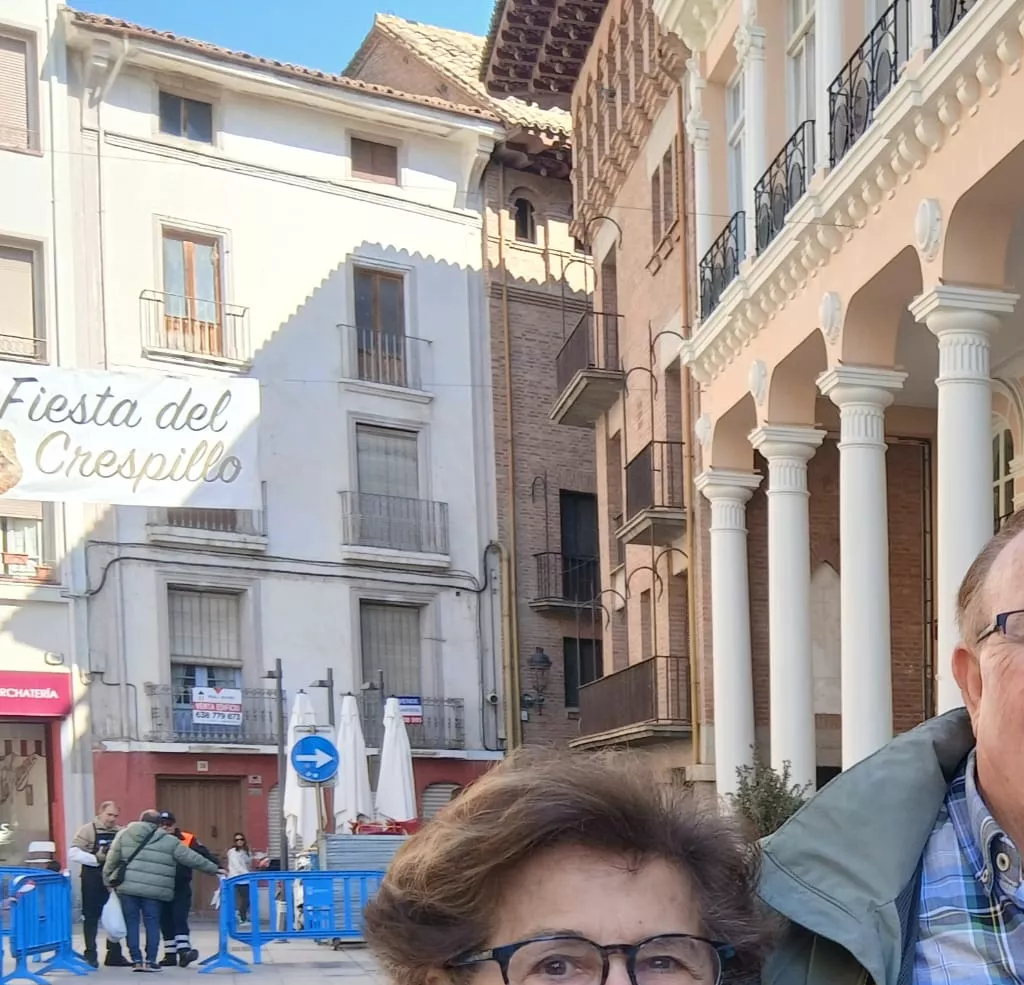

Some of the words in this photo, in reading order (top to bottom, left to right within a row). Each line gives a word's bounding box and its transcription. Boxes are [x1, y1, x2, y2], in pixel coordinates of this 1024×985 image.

[0, 376, 142, 428] Fiesta
[155, 387, 232, 433] del
[35, 430, 243, 493] Crespillo
